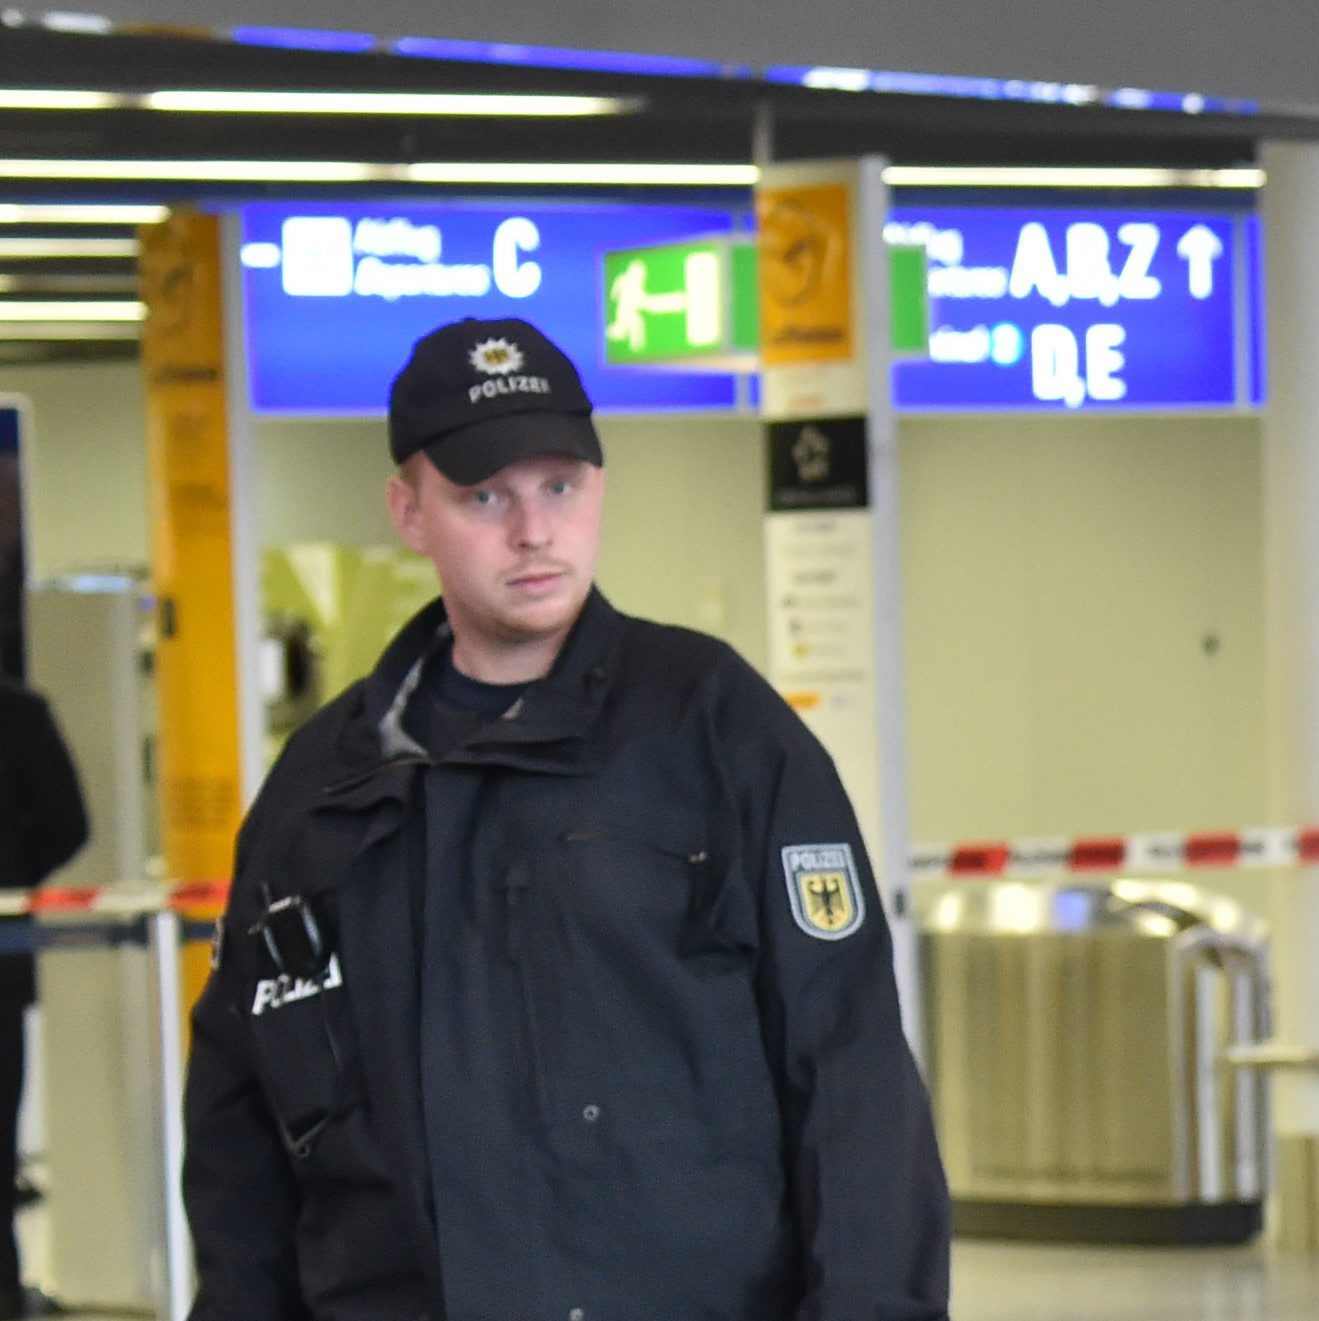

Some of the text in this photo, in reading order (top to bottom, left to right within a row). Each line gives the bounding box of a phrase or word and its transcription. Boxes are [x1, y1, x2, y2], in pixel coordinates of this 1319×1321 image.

[493, 217, 542, 298] C
[468, 376, 551, 403] POLIZEI
[789, 851, 847, 872] POLIZEI
